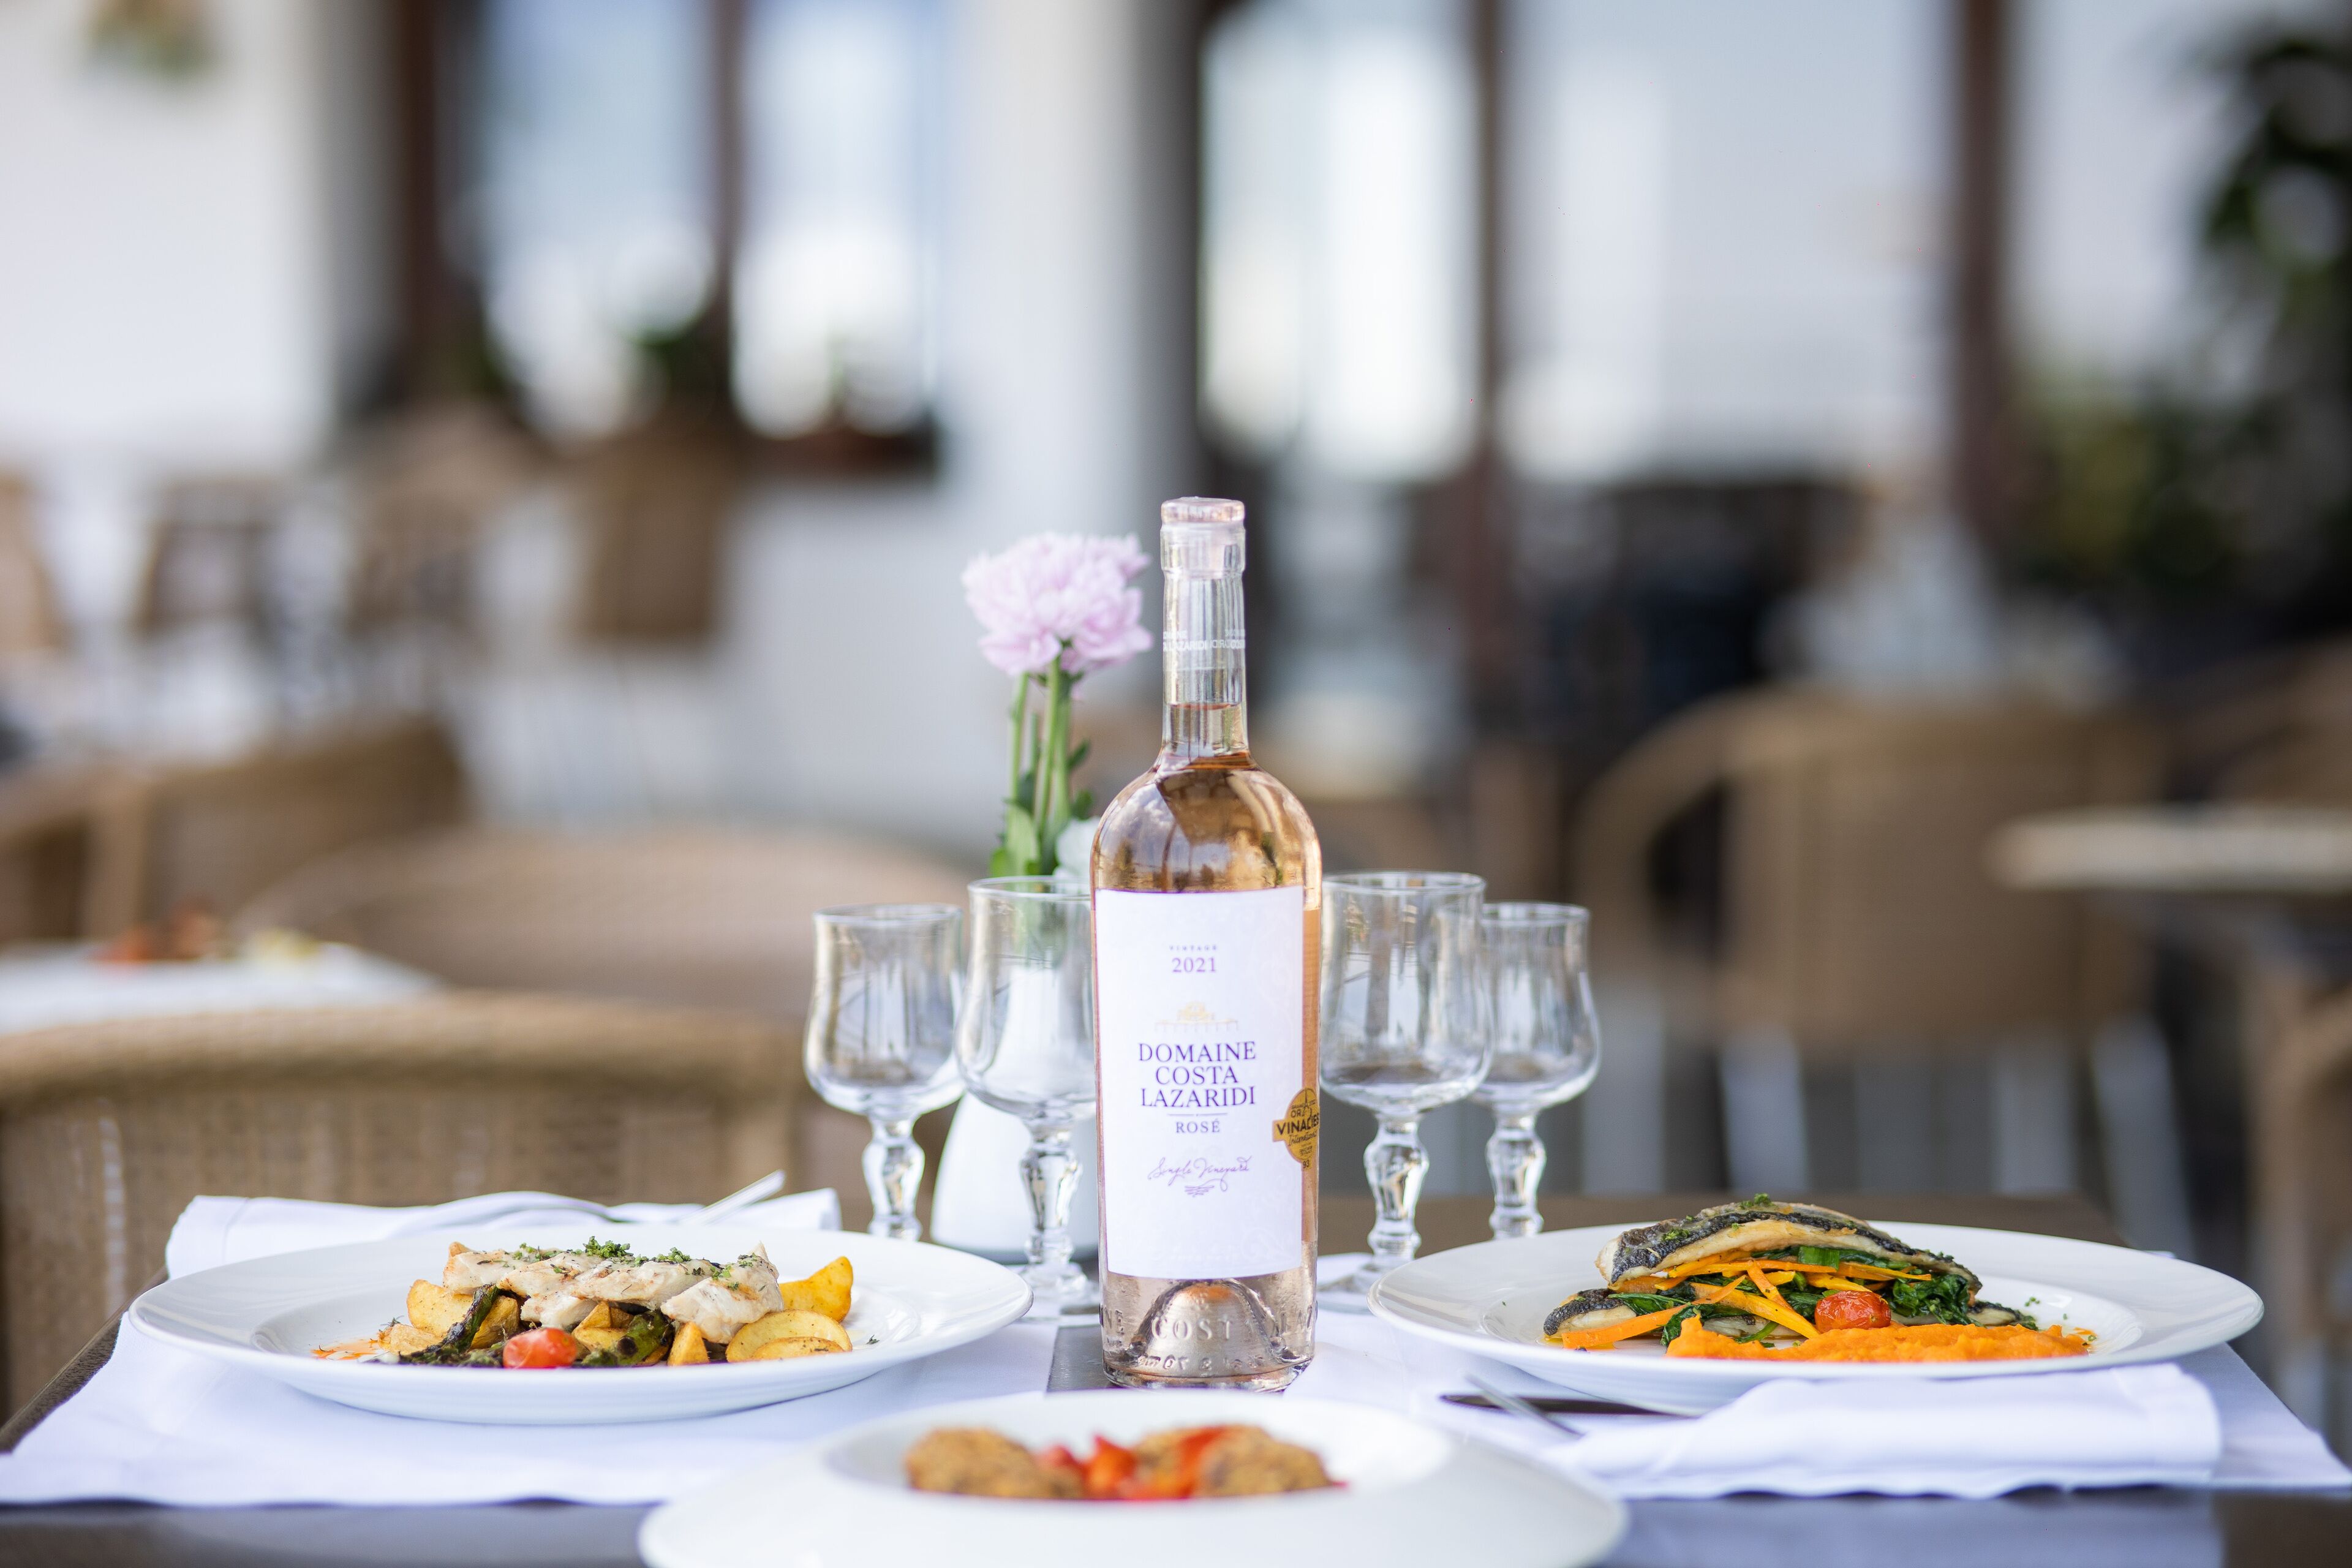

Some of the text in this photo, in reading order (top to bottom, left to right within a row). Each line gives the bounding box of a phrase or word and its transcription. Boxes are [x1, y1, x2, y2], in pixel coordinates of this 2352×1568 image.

[1172, 957, 1216, 973] 2021
[1138, 1041, 1256, 1063] DOMAINE
[1156, 1065, 1239, 1085] COSTA
[1140, 1085, 1256, 1107] LAZARIDI
[1175, 1118, 1221, 1134] ROSÉ
[1303, 1159, 1310, 1169] 93
[1151, 1314, 1256, 1341] COST
